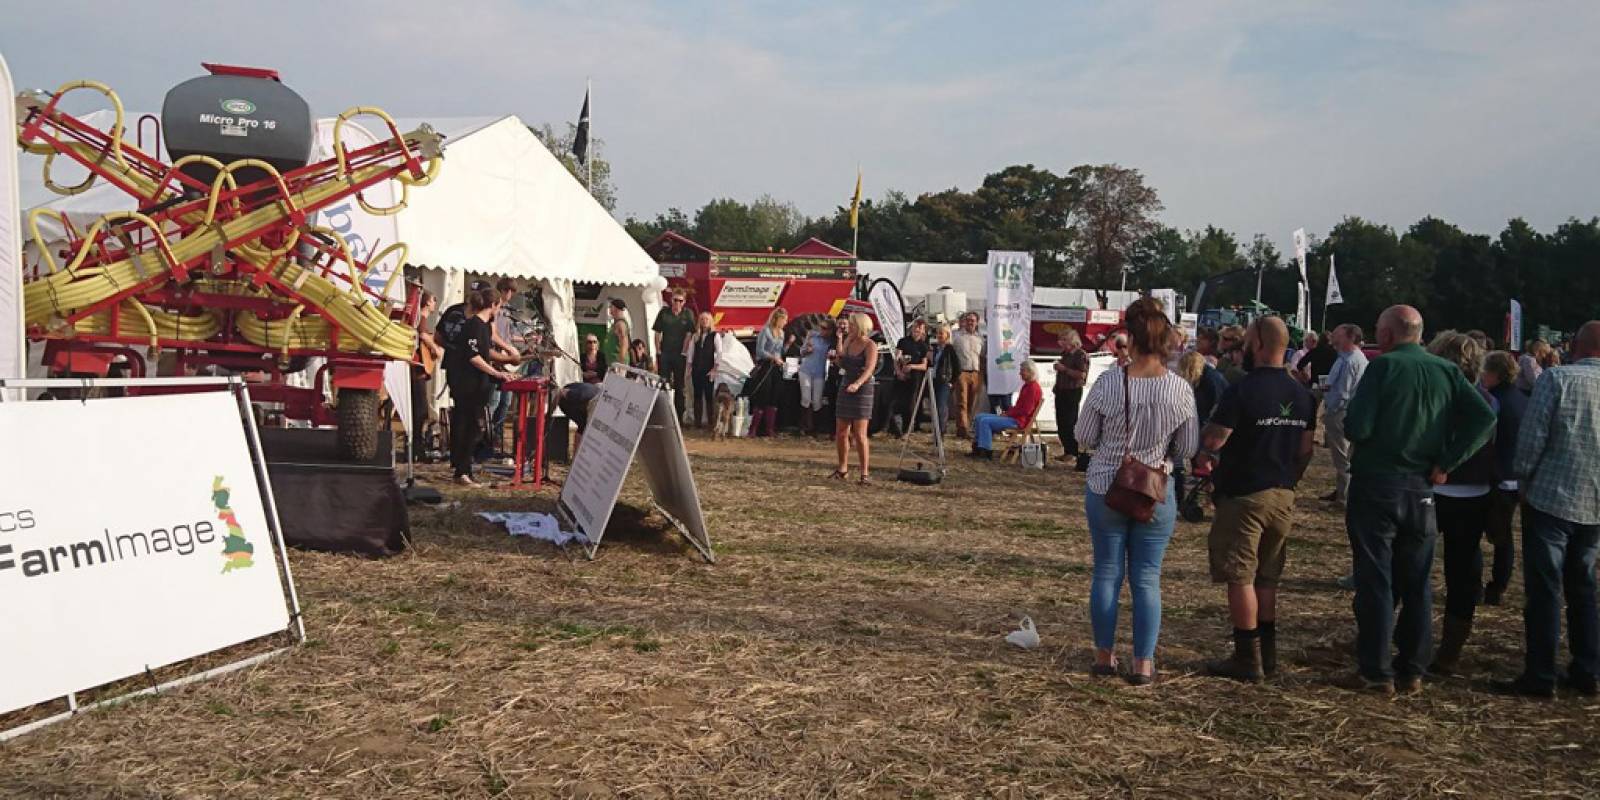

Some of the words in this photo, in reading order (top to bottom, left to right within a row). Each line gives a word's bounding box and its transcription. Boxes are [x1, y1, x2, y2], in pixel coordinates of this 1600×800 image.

[199, 113, 234, 125] Micro
[238, 117, 259, 128] Pro
[263, 119, 276, 129] 16
